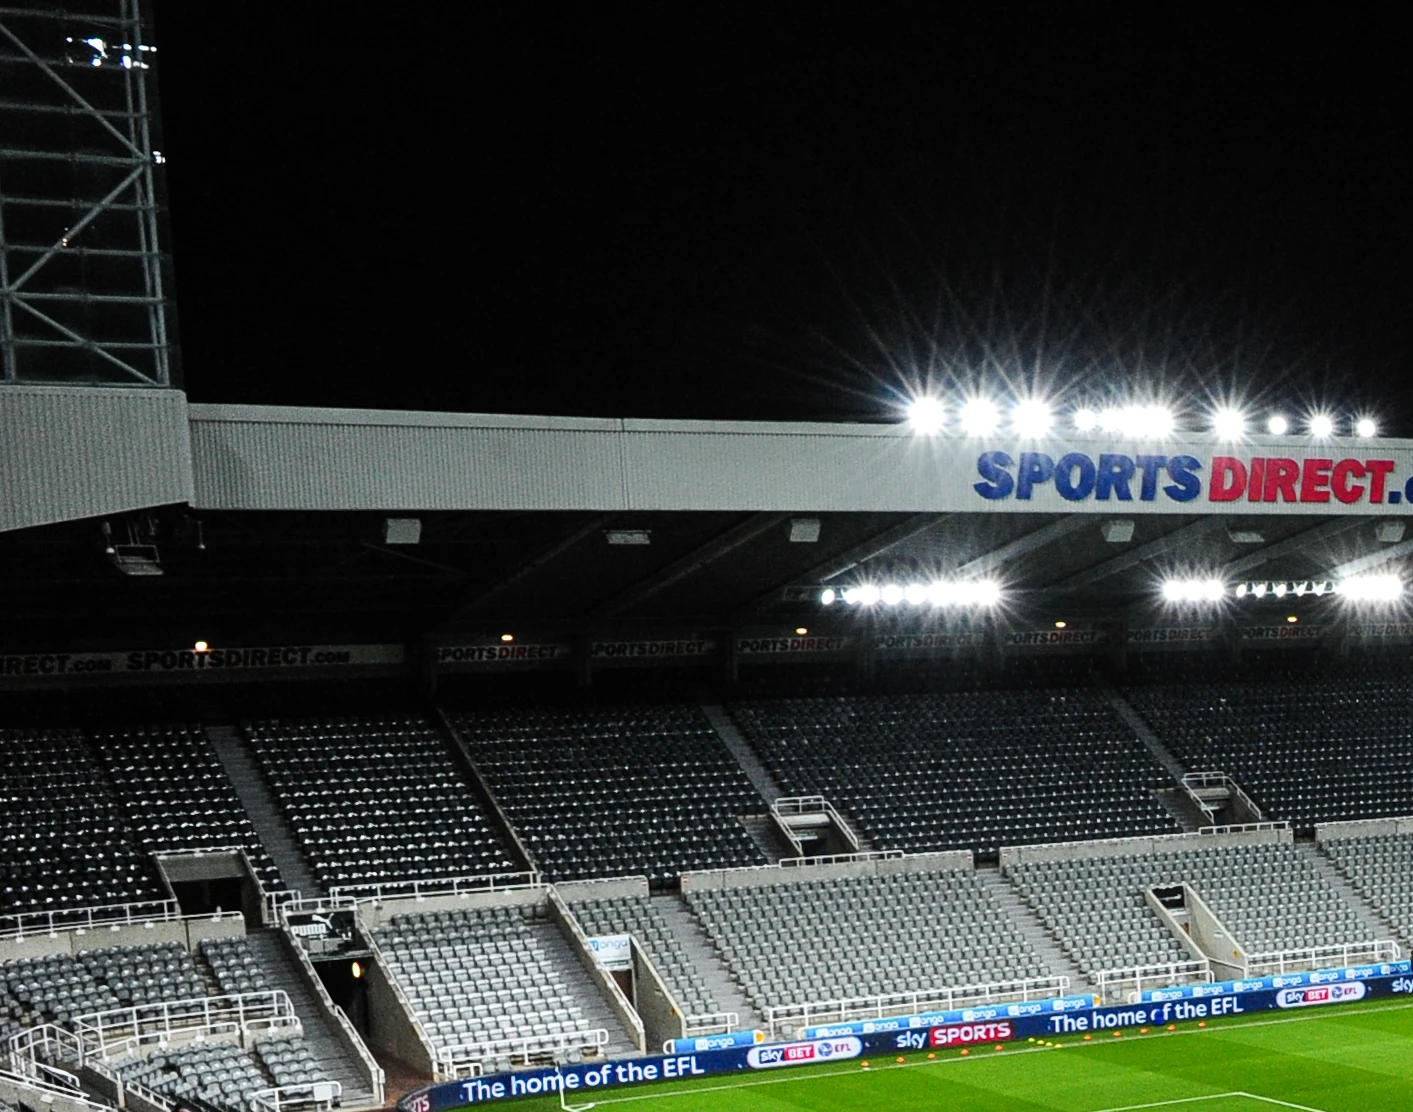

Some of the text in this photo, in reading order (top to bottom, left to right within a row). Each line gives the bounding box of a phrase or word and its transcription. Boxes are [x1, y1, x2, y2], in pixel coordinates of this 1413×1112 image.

[1286, 991, 1304, 1004] sky
[1307, 989, 1327, 1000] BET
[1050, 1014, 1088, 1033] The
[1092, 1007, 1146, 1028] home
[1175, 1000, 1208, 1019] the
[1211, 997, 1243, 1015] EFL
[896, 1023, 1010, 1049] sky SPORTS
[759, 1047, 783, 1063] sky
[787, 1045, 811, 1058] BET
[463, 1056, 705, 1102] The home of the EFL
